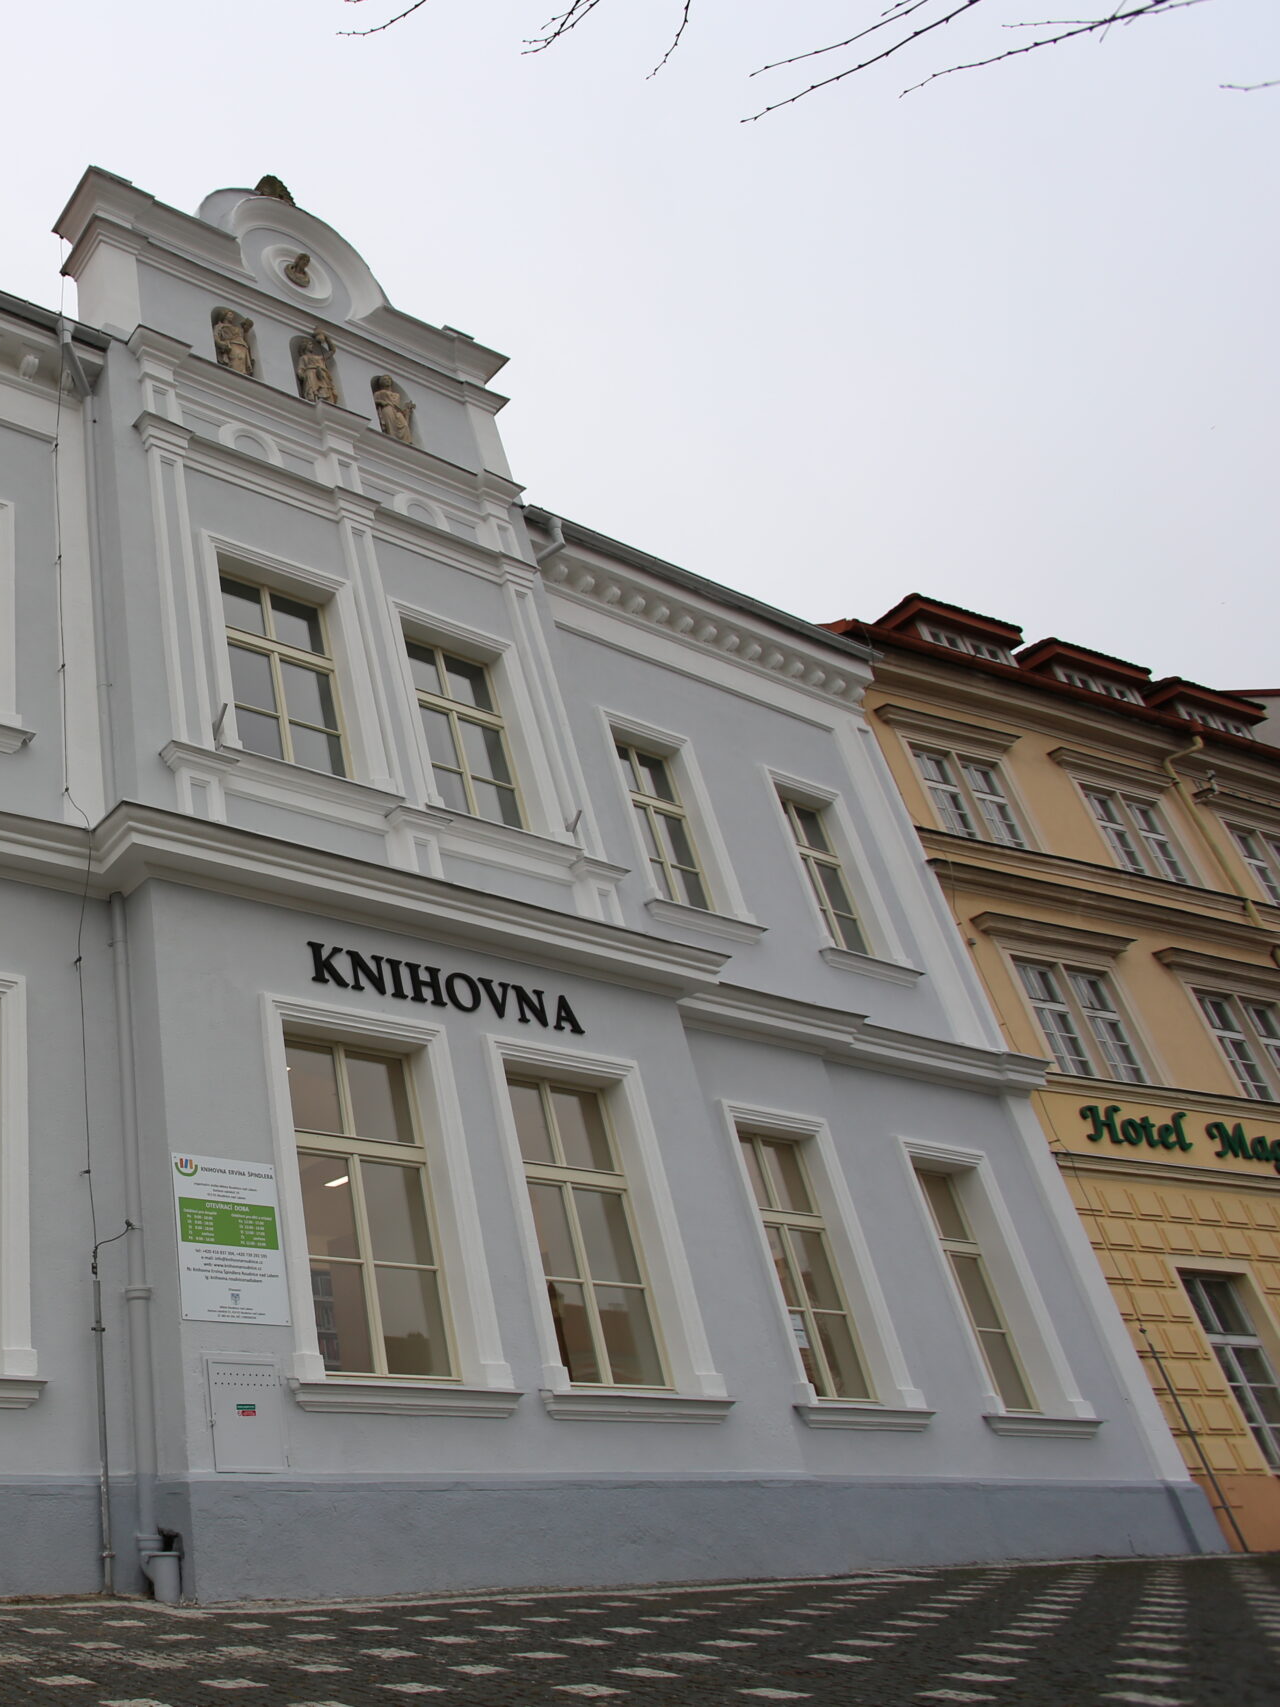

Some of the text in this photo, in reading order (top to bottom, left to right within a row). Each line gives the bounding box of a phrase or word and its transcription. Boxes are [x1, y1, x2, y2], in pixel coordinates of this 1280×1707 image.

[307, 940, 586, 1035] KNIHOVNA
[1079, 1104, 1194, 1152] Hotel
[201, 1166, 226, 1174] KNIHOVNA
